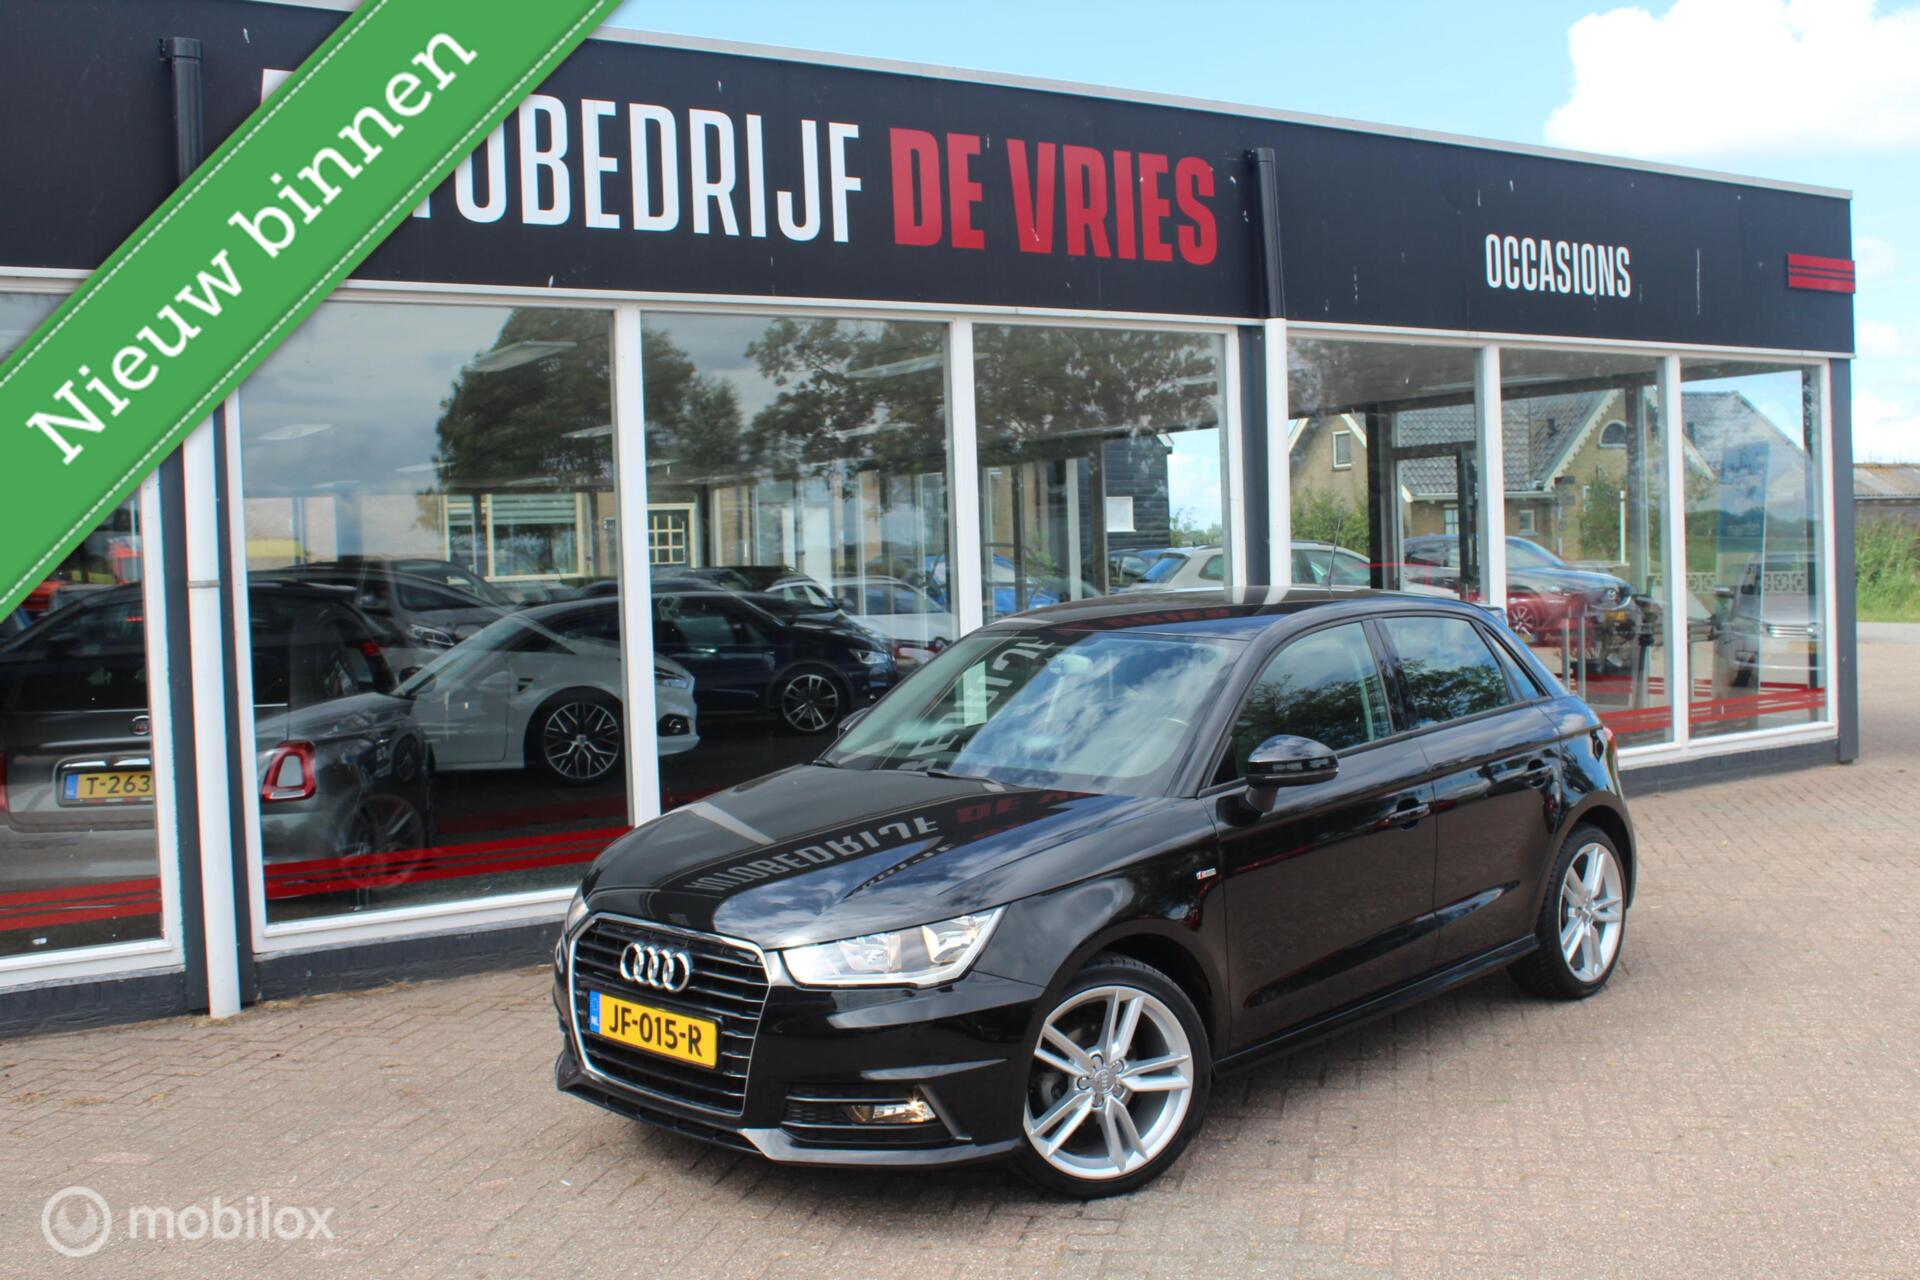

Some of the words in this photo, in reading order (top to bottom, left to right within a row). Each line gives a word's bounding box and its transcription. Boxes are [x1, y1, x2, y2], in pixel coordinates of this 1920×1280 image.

[412, 93, 862, 243] OBEDRIJF
[889, 127, 985, 250] DE
[1006, 138, 1218, 265] VRIES
[1485, 233, 1631, 298] OCCASIONS
[609, 1004, 703, 1057] JF-015-R
